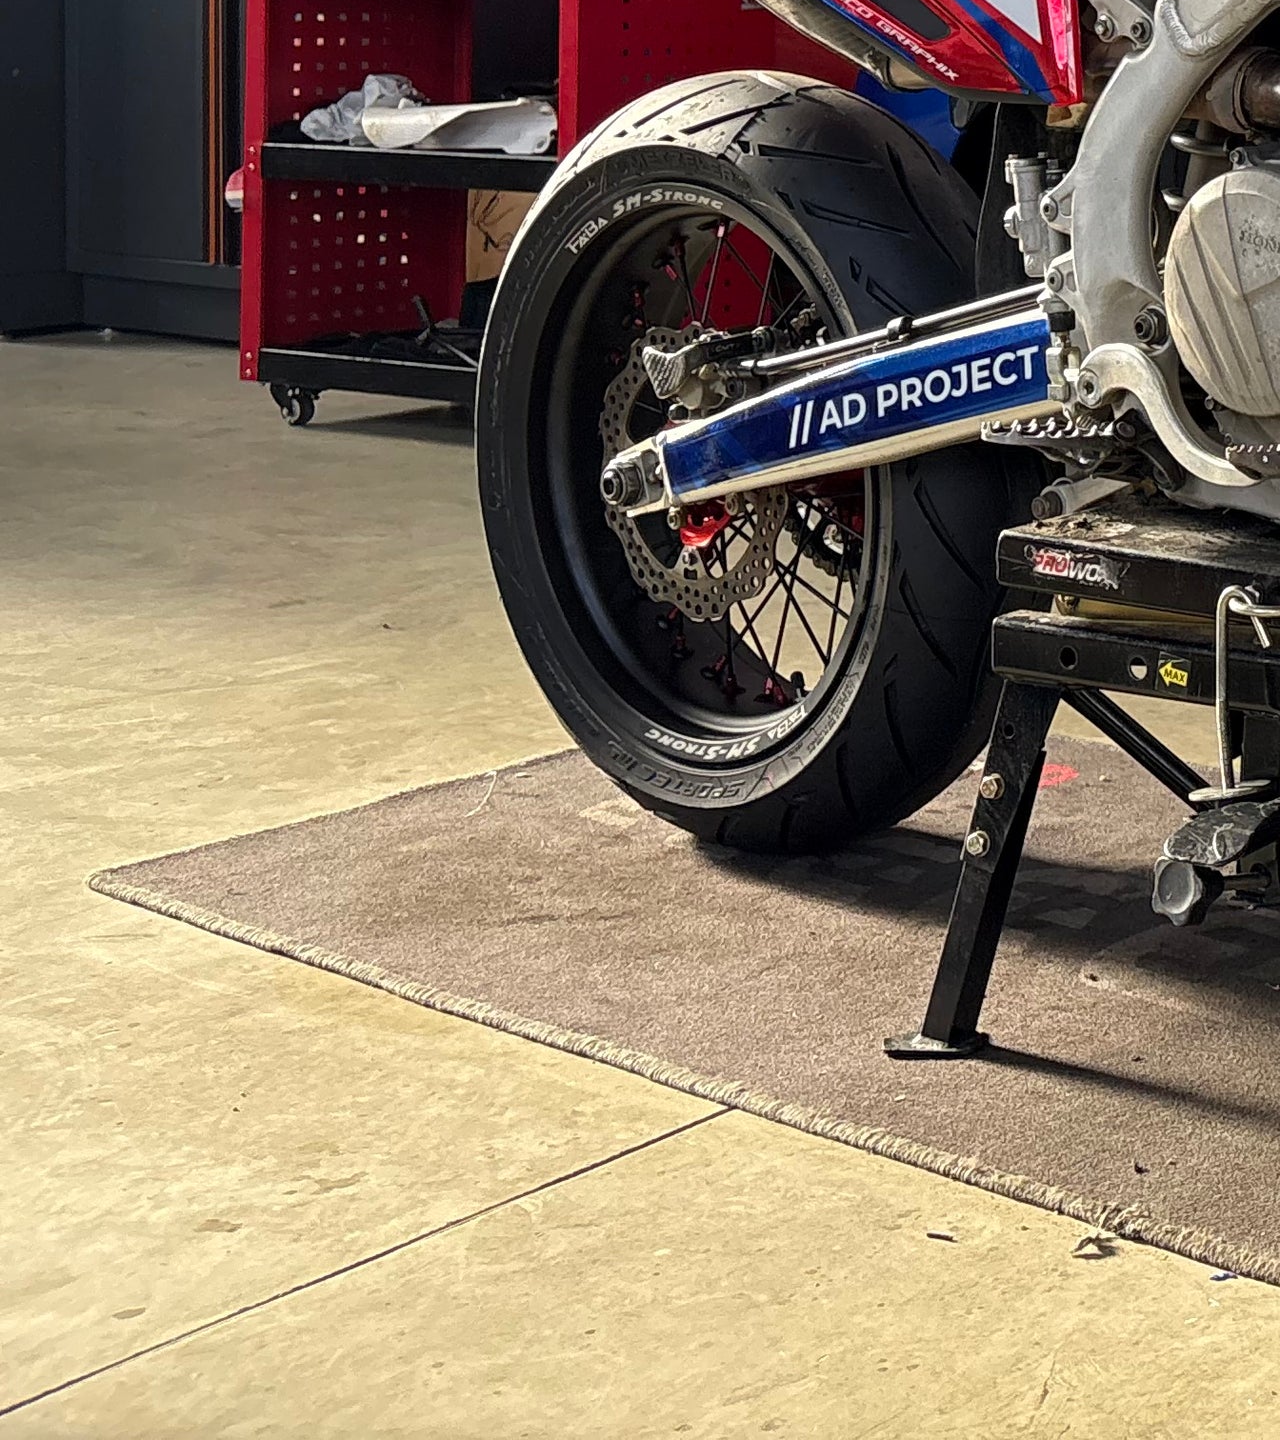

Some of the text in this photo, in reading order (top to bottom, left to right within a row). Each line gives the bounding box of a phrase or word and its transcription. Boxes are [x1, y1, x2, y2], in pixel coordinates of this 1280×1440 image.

[875, 20, 960, 82] GRAPHIX
[876, 344, 1040, 419] PROJECT
[1163, 667, 1187, 684] MAX
